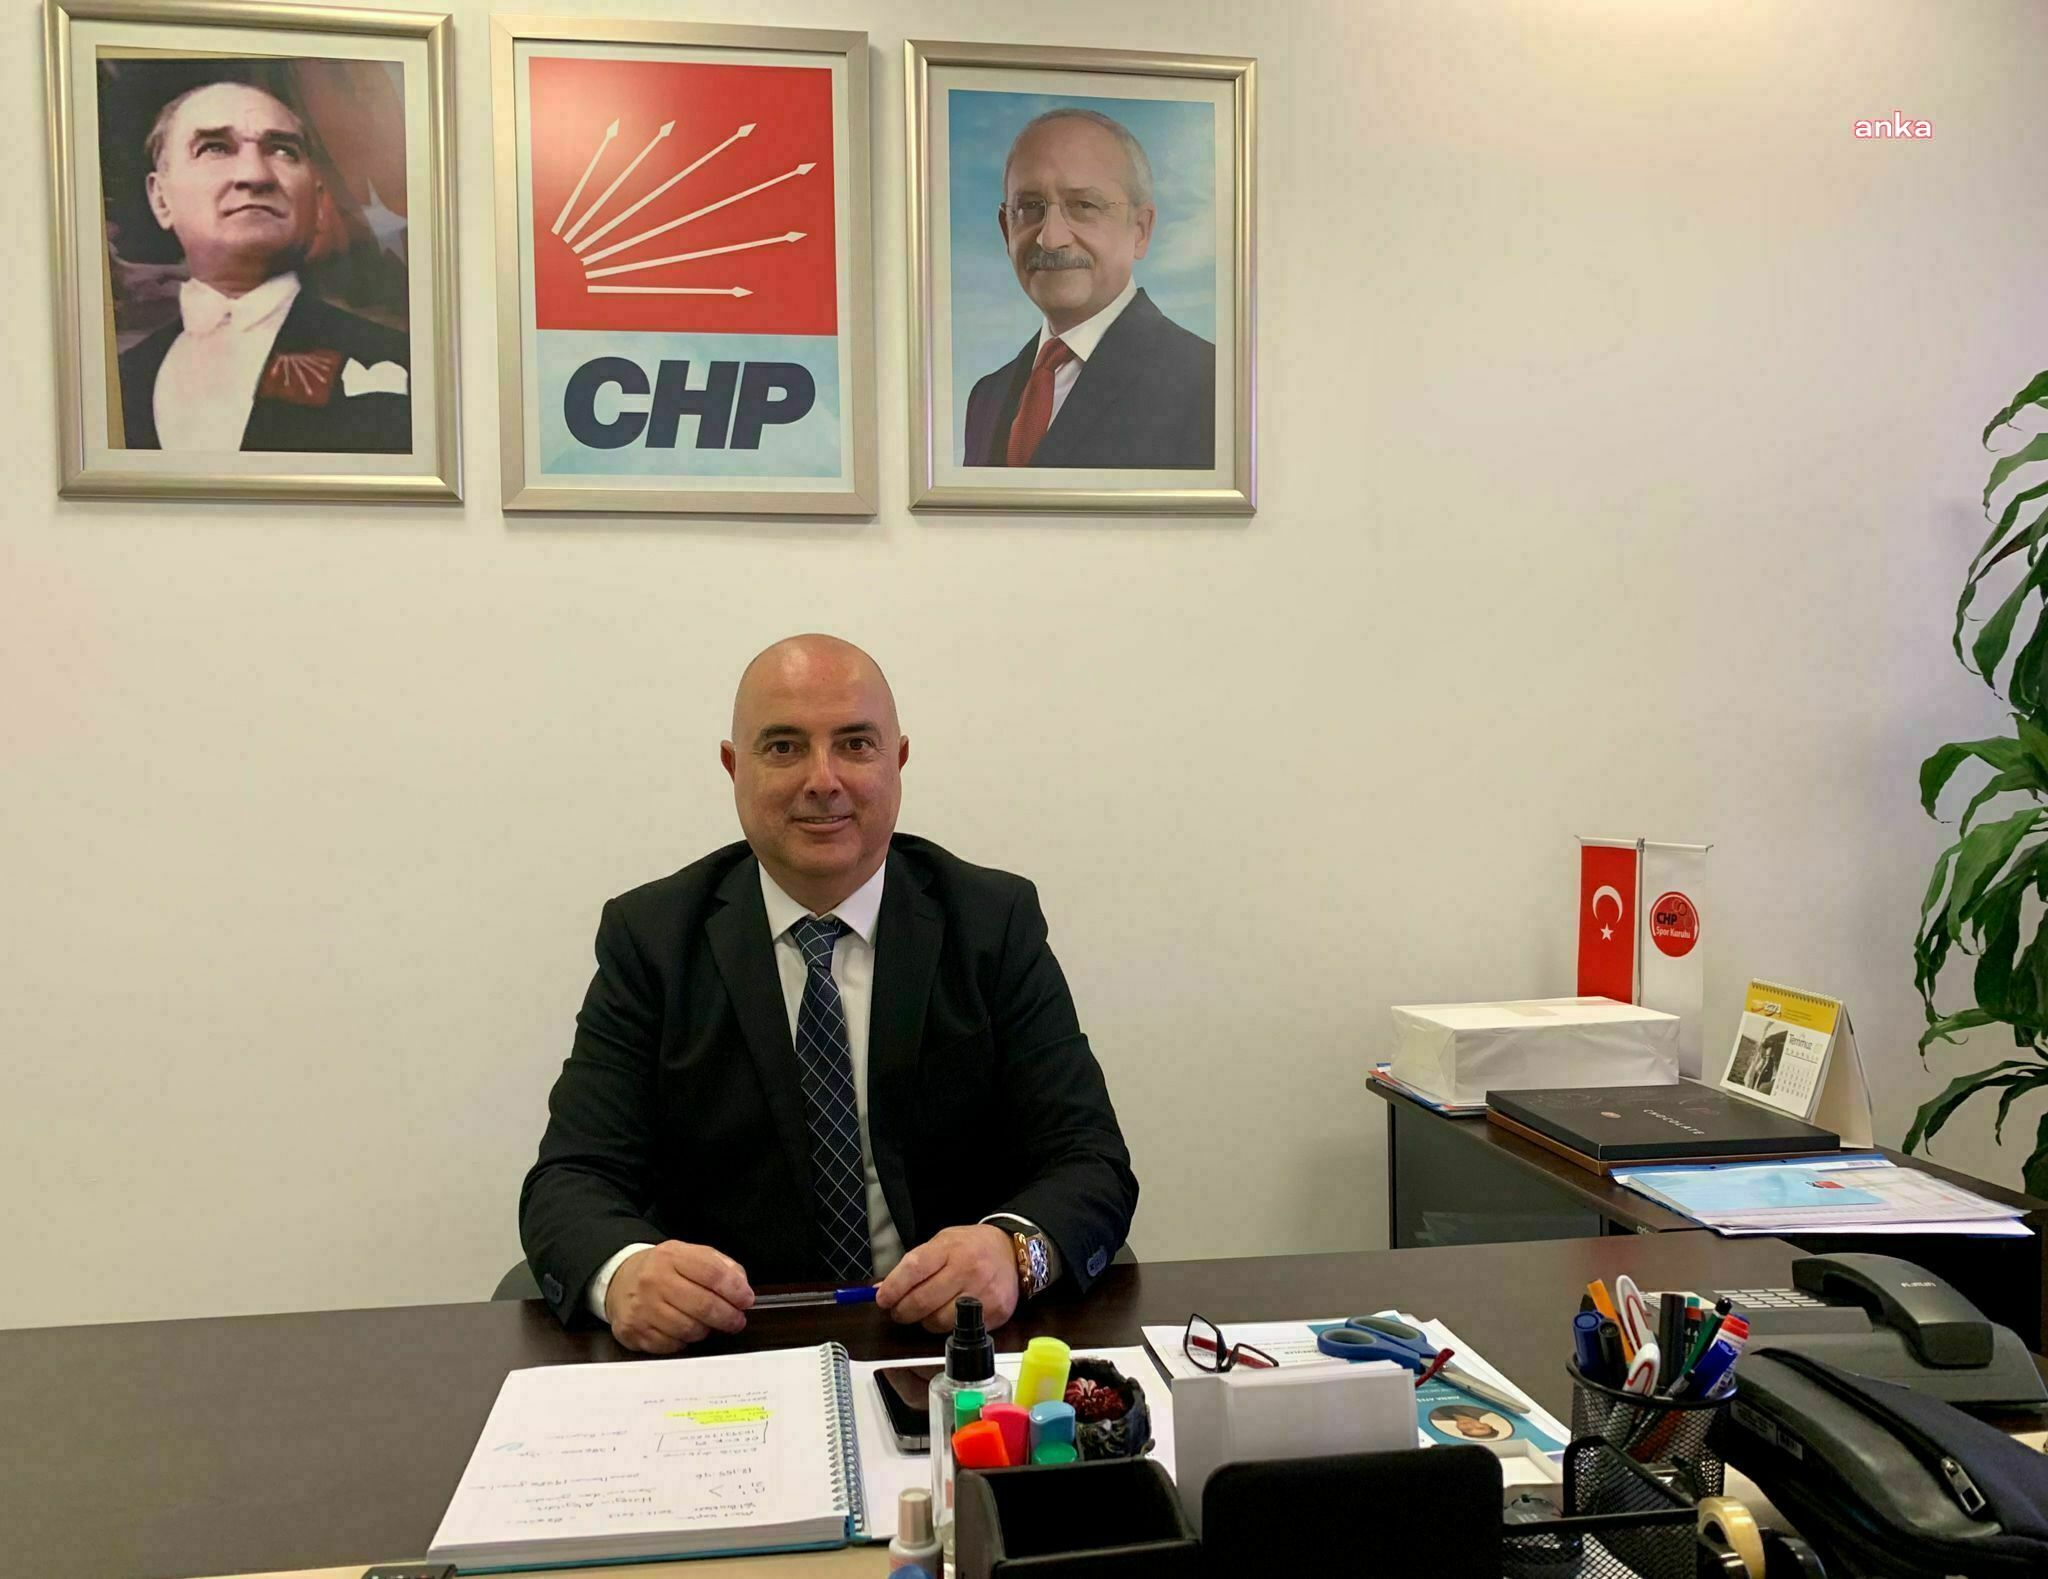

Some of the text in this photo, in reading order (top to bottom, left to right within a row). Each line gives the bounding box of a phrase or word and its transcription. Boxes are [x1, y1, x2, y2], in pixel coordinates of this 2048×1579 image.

[564, 356, 816, 449] CHP
[1656, 912, 1678, 925] CHP
[1656, 926, 1669, 936] Spor
